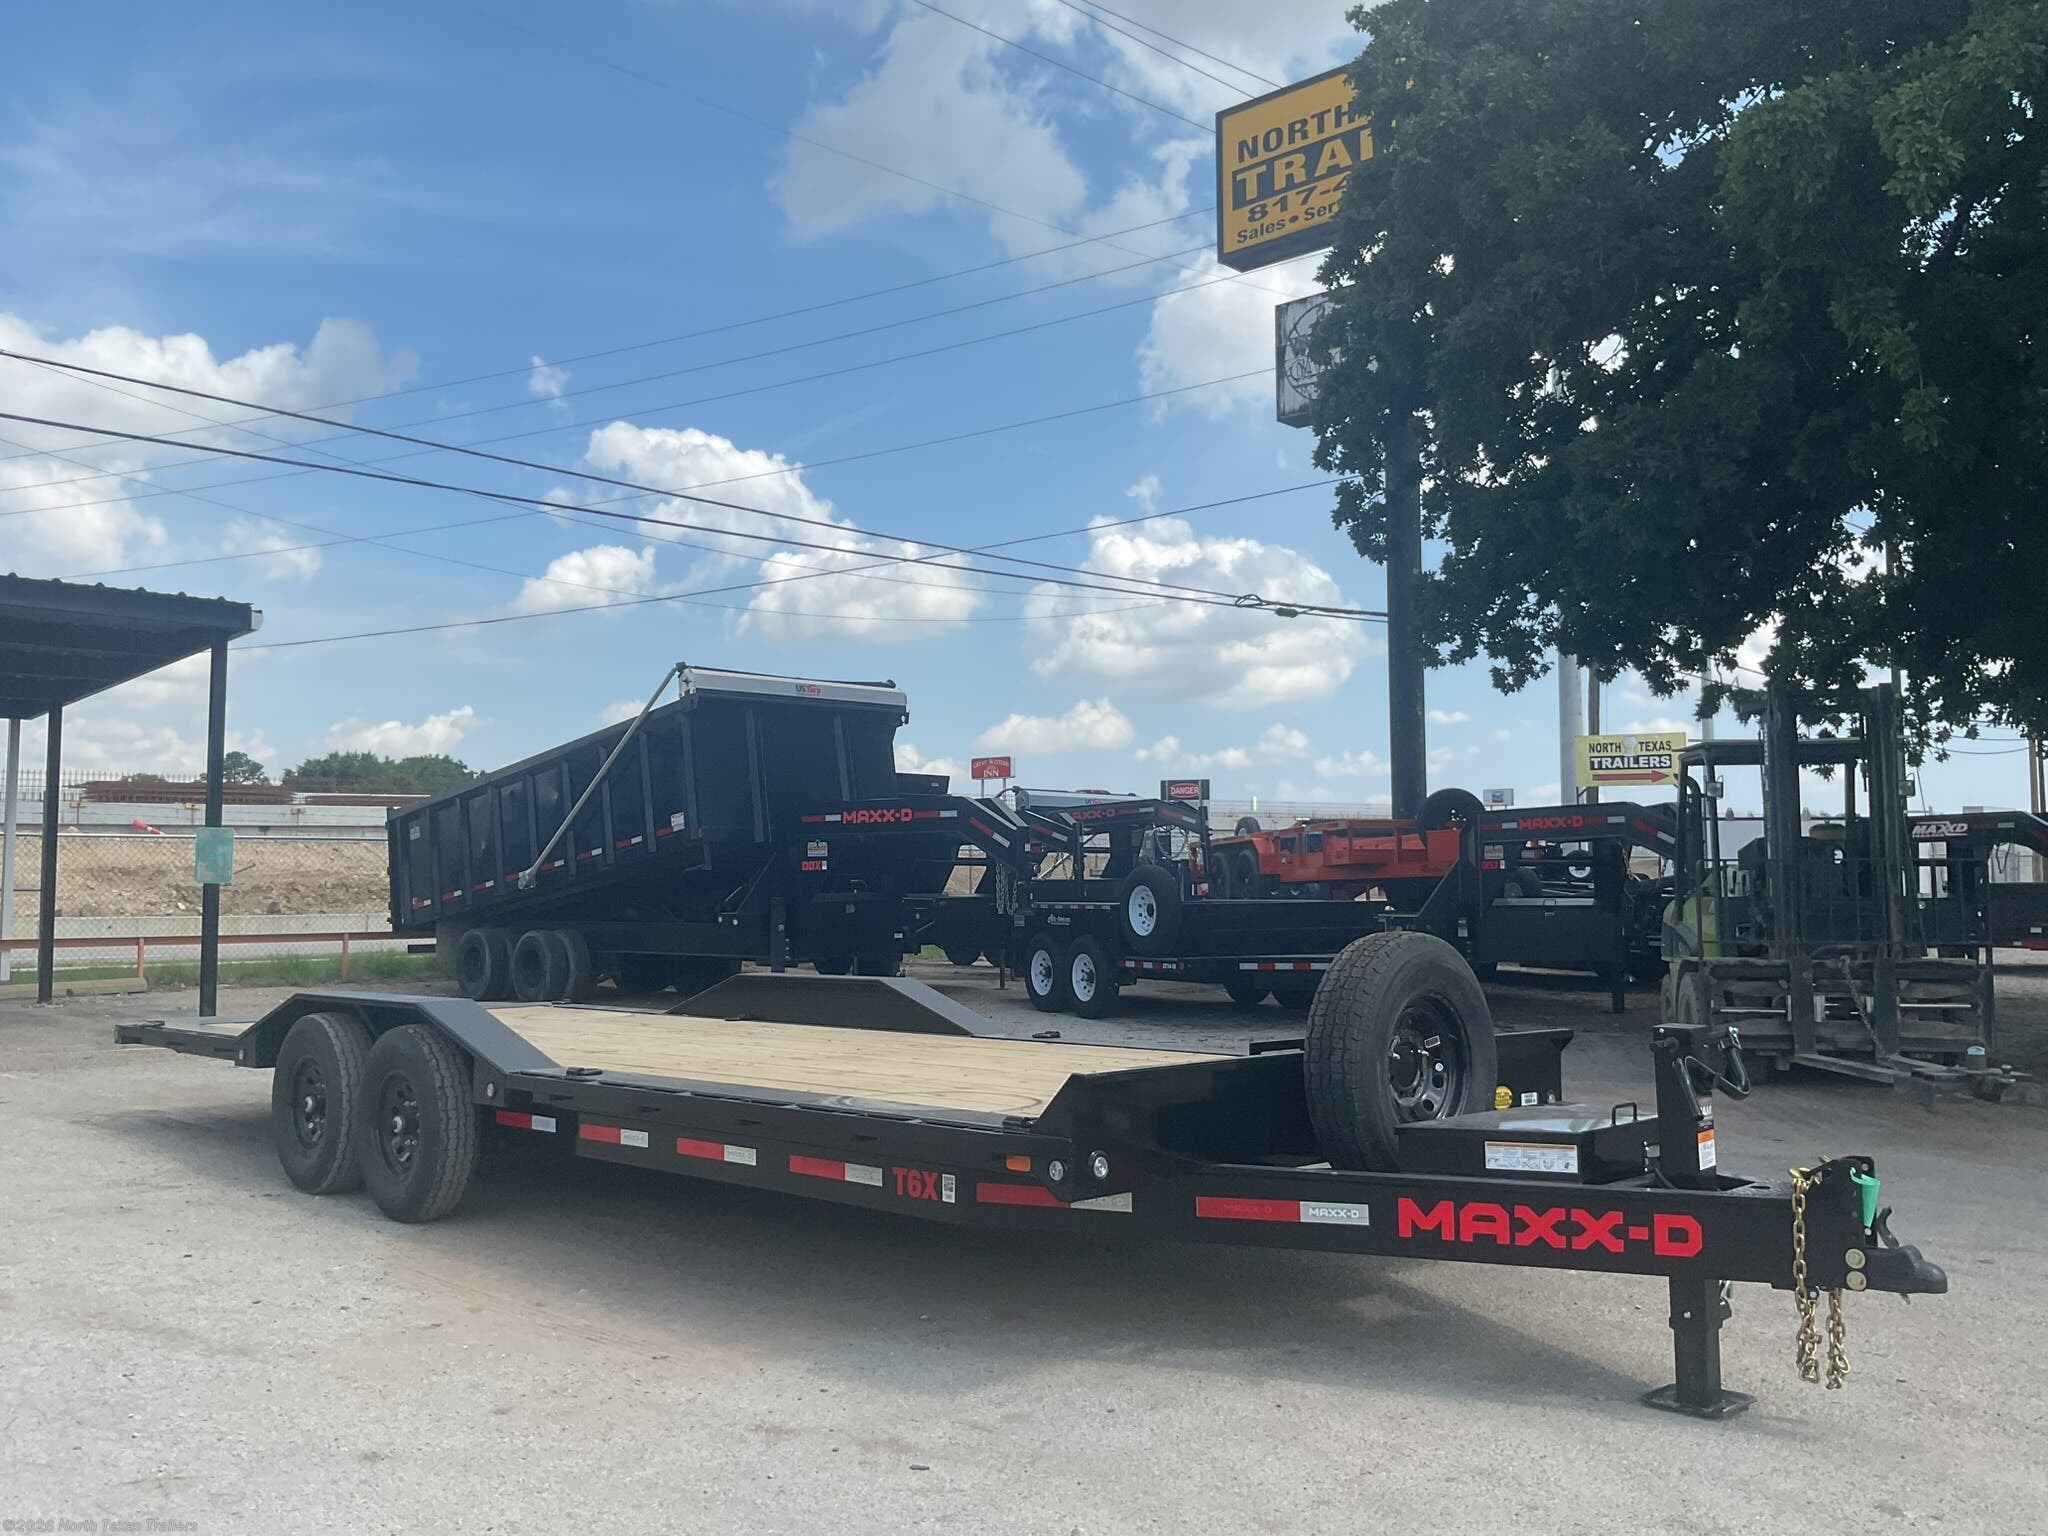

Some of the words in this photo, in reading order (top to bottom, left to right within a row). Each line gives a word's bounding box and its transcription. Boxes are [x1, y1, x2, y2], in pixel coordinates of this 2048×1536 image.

[1238, 102, 1357, 163] NORTH
[1237, 217, 1286, 244] Sales
[1589, 742, 1621, 754] NORTH
[1639, 740, 1671, 751] TEXAS
[1591, 754, 1671, 769] TRAILERS
[984, 769, 998, 777] INN
[1170, 786, 1200, 795] DANGER
[842, 808, 913, 824] MAXX-D
[1071, 809, 1116, 820] AXX-D
[1518, 816, 1584, 830] MAXX-D
[892, 1167, 938, 1200] T6X
[1308, 1208, 1360, 1218] MAXX-D
[1398, 1197, 1703, 1257] MAXX-D
